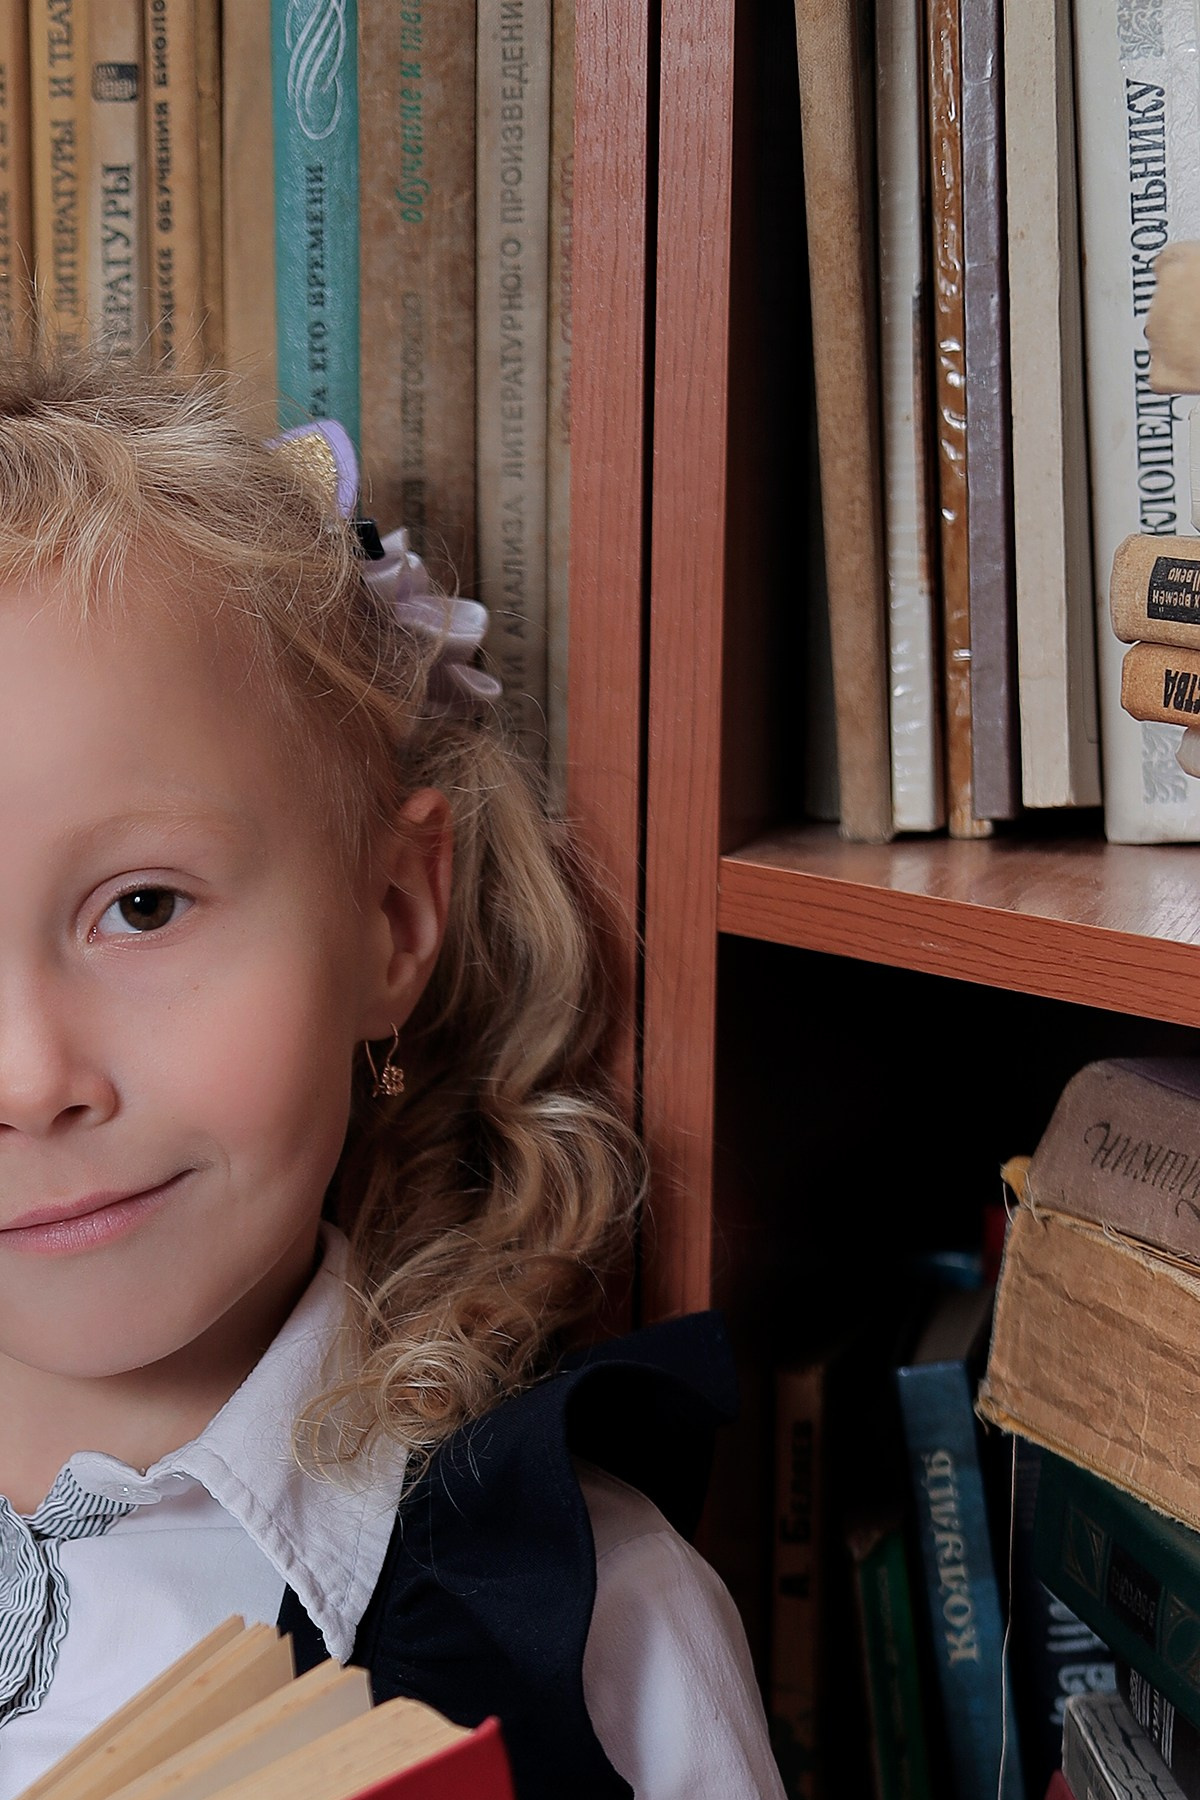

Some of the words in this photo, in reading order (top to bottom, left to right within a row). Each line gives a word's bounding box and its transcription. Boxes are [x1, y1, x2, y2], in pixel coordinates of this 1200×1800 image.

[50, 76, 73, 100] И
[399, 60, 423, 80] и
[52, 119, 78, 317] ЛИТЕРАТУРЫ
[152, 102, 174, 234] ОБУЧЕНИЯ
[395, 92, 431, 225] обучение
[305, 162, 327, 308] ВРЕМЕНИ
[307, 320, 329, 373] ЕГО
[499, 237, 524, 480] ЛИТЕРАТУРНОГО
[501, 497, 525, 640] АНАЛИЗА
